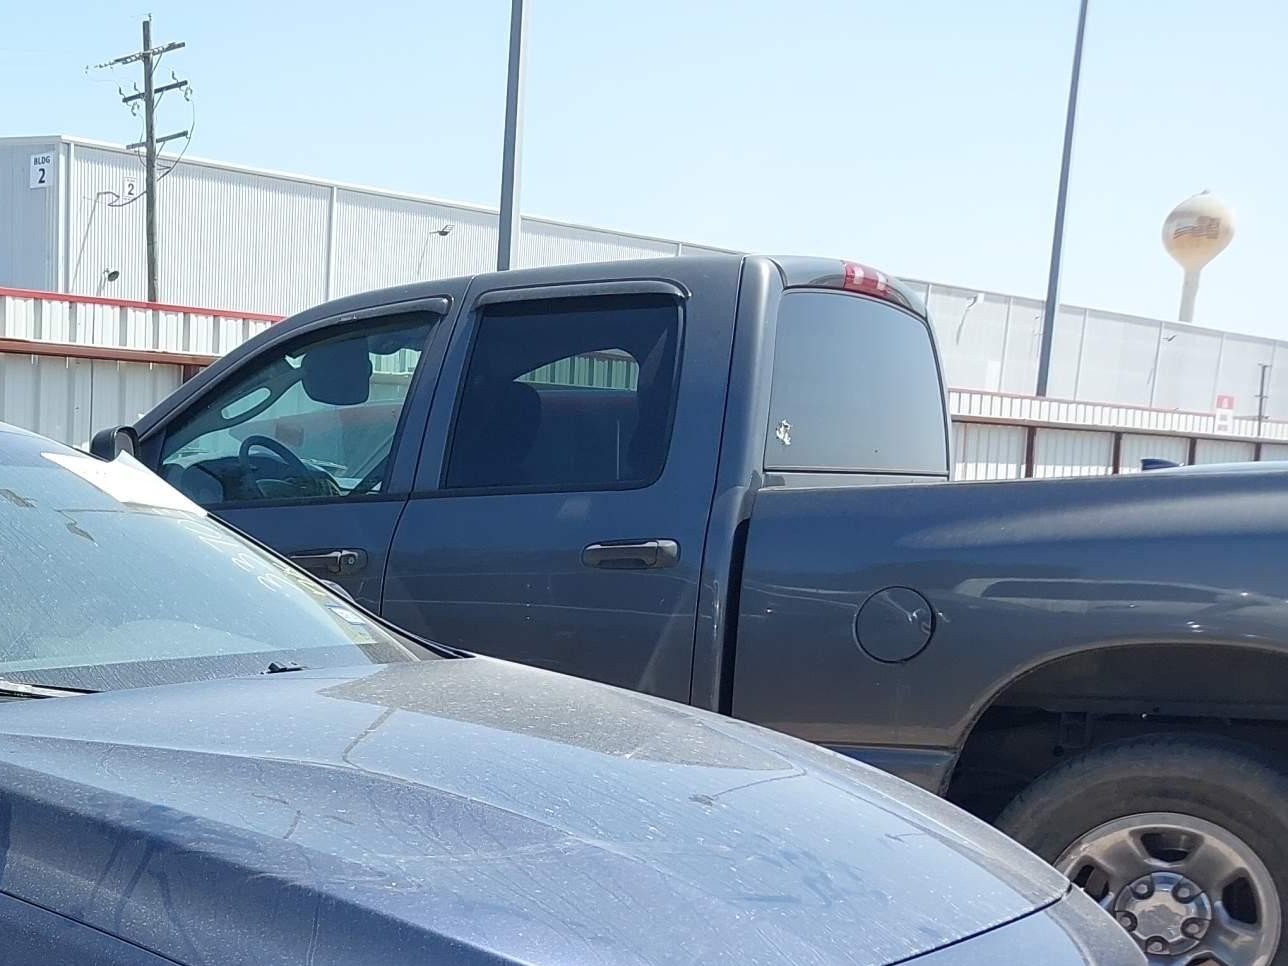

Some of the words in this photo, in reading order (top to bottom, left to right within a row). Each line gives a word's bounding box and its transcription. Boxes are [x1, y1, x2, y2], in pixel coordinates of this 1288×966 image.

[33, 155, 51, 166] BLDG
[38, 168, 46, 184] 2
[127, 183, 135, 196] 2
